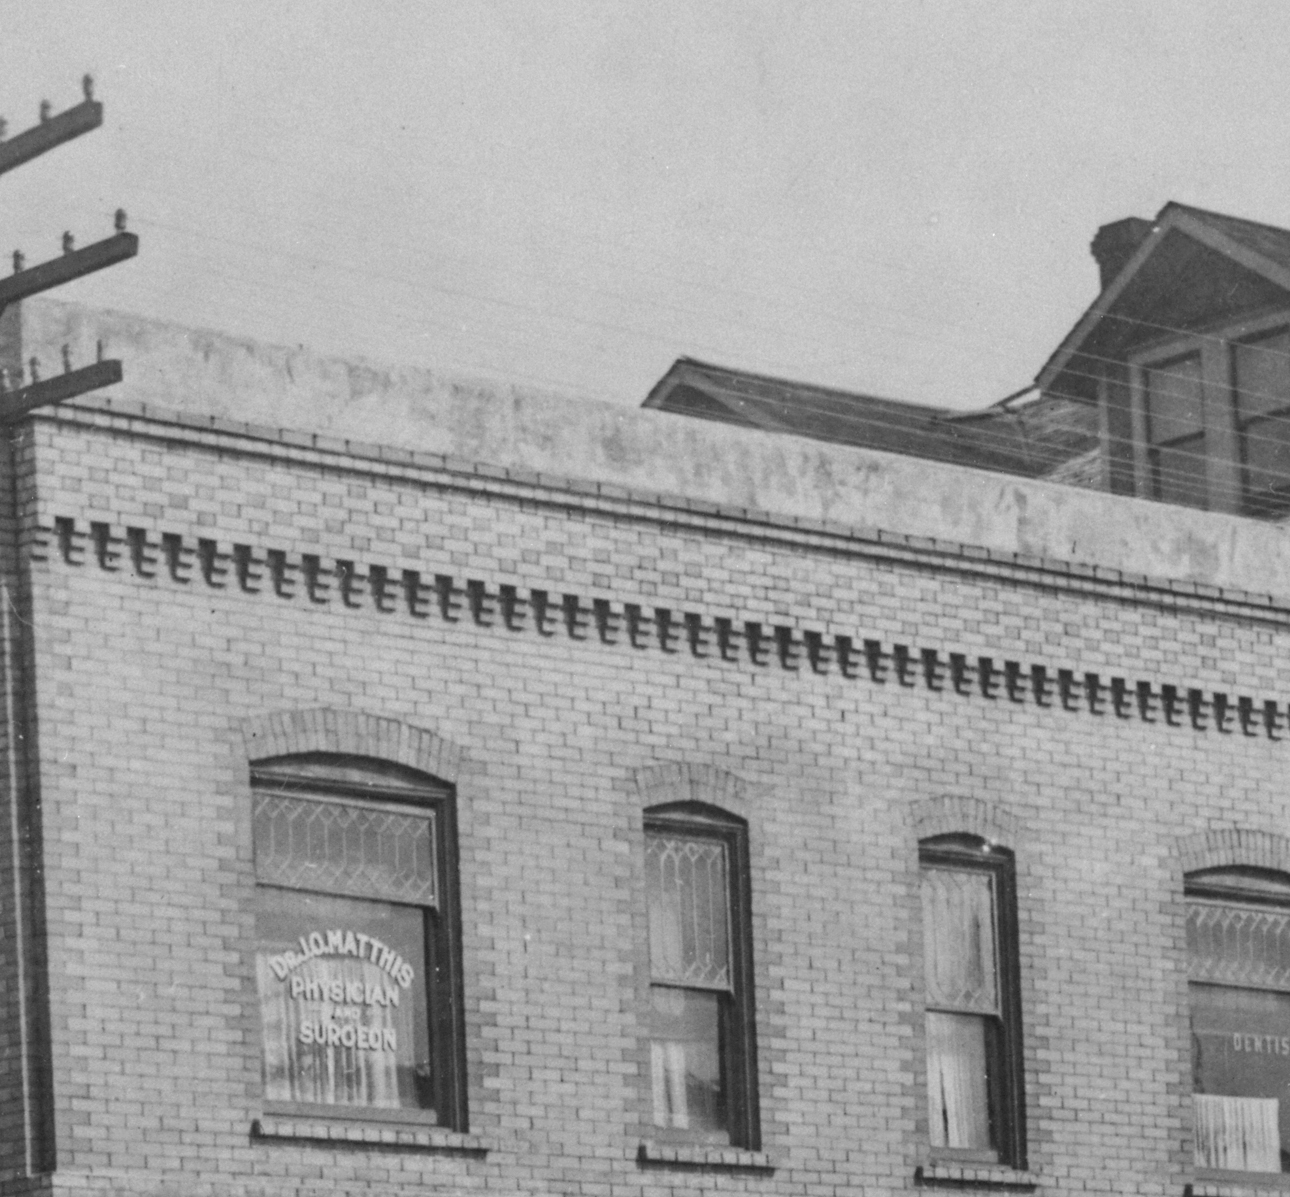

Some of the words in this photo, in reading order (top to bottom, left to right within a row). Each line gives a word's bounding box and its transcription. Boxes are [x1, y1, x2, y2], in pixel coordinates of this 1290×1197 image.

[325, 929, 415, 989] MATTHIS
[291, 976, 399, 1007] PHYSICIAN
[298, 1020, 398, 1051] SURGEON
